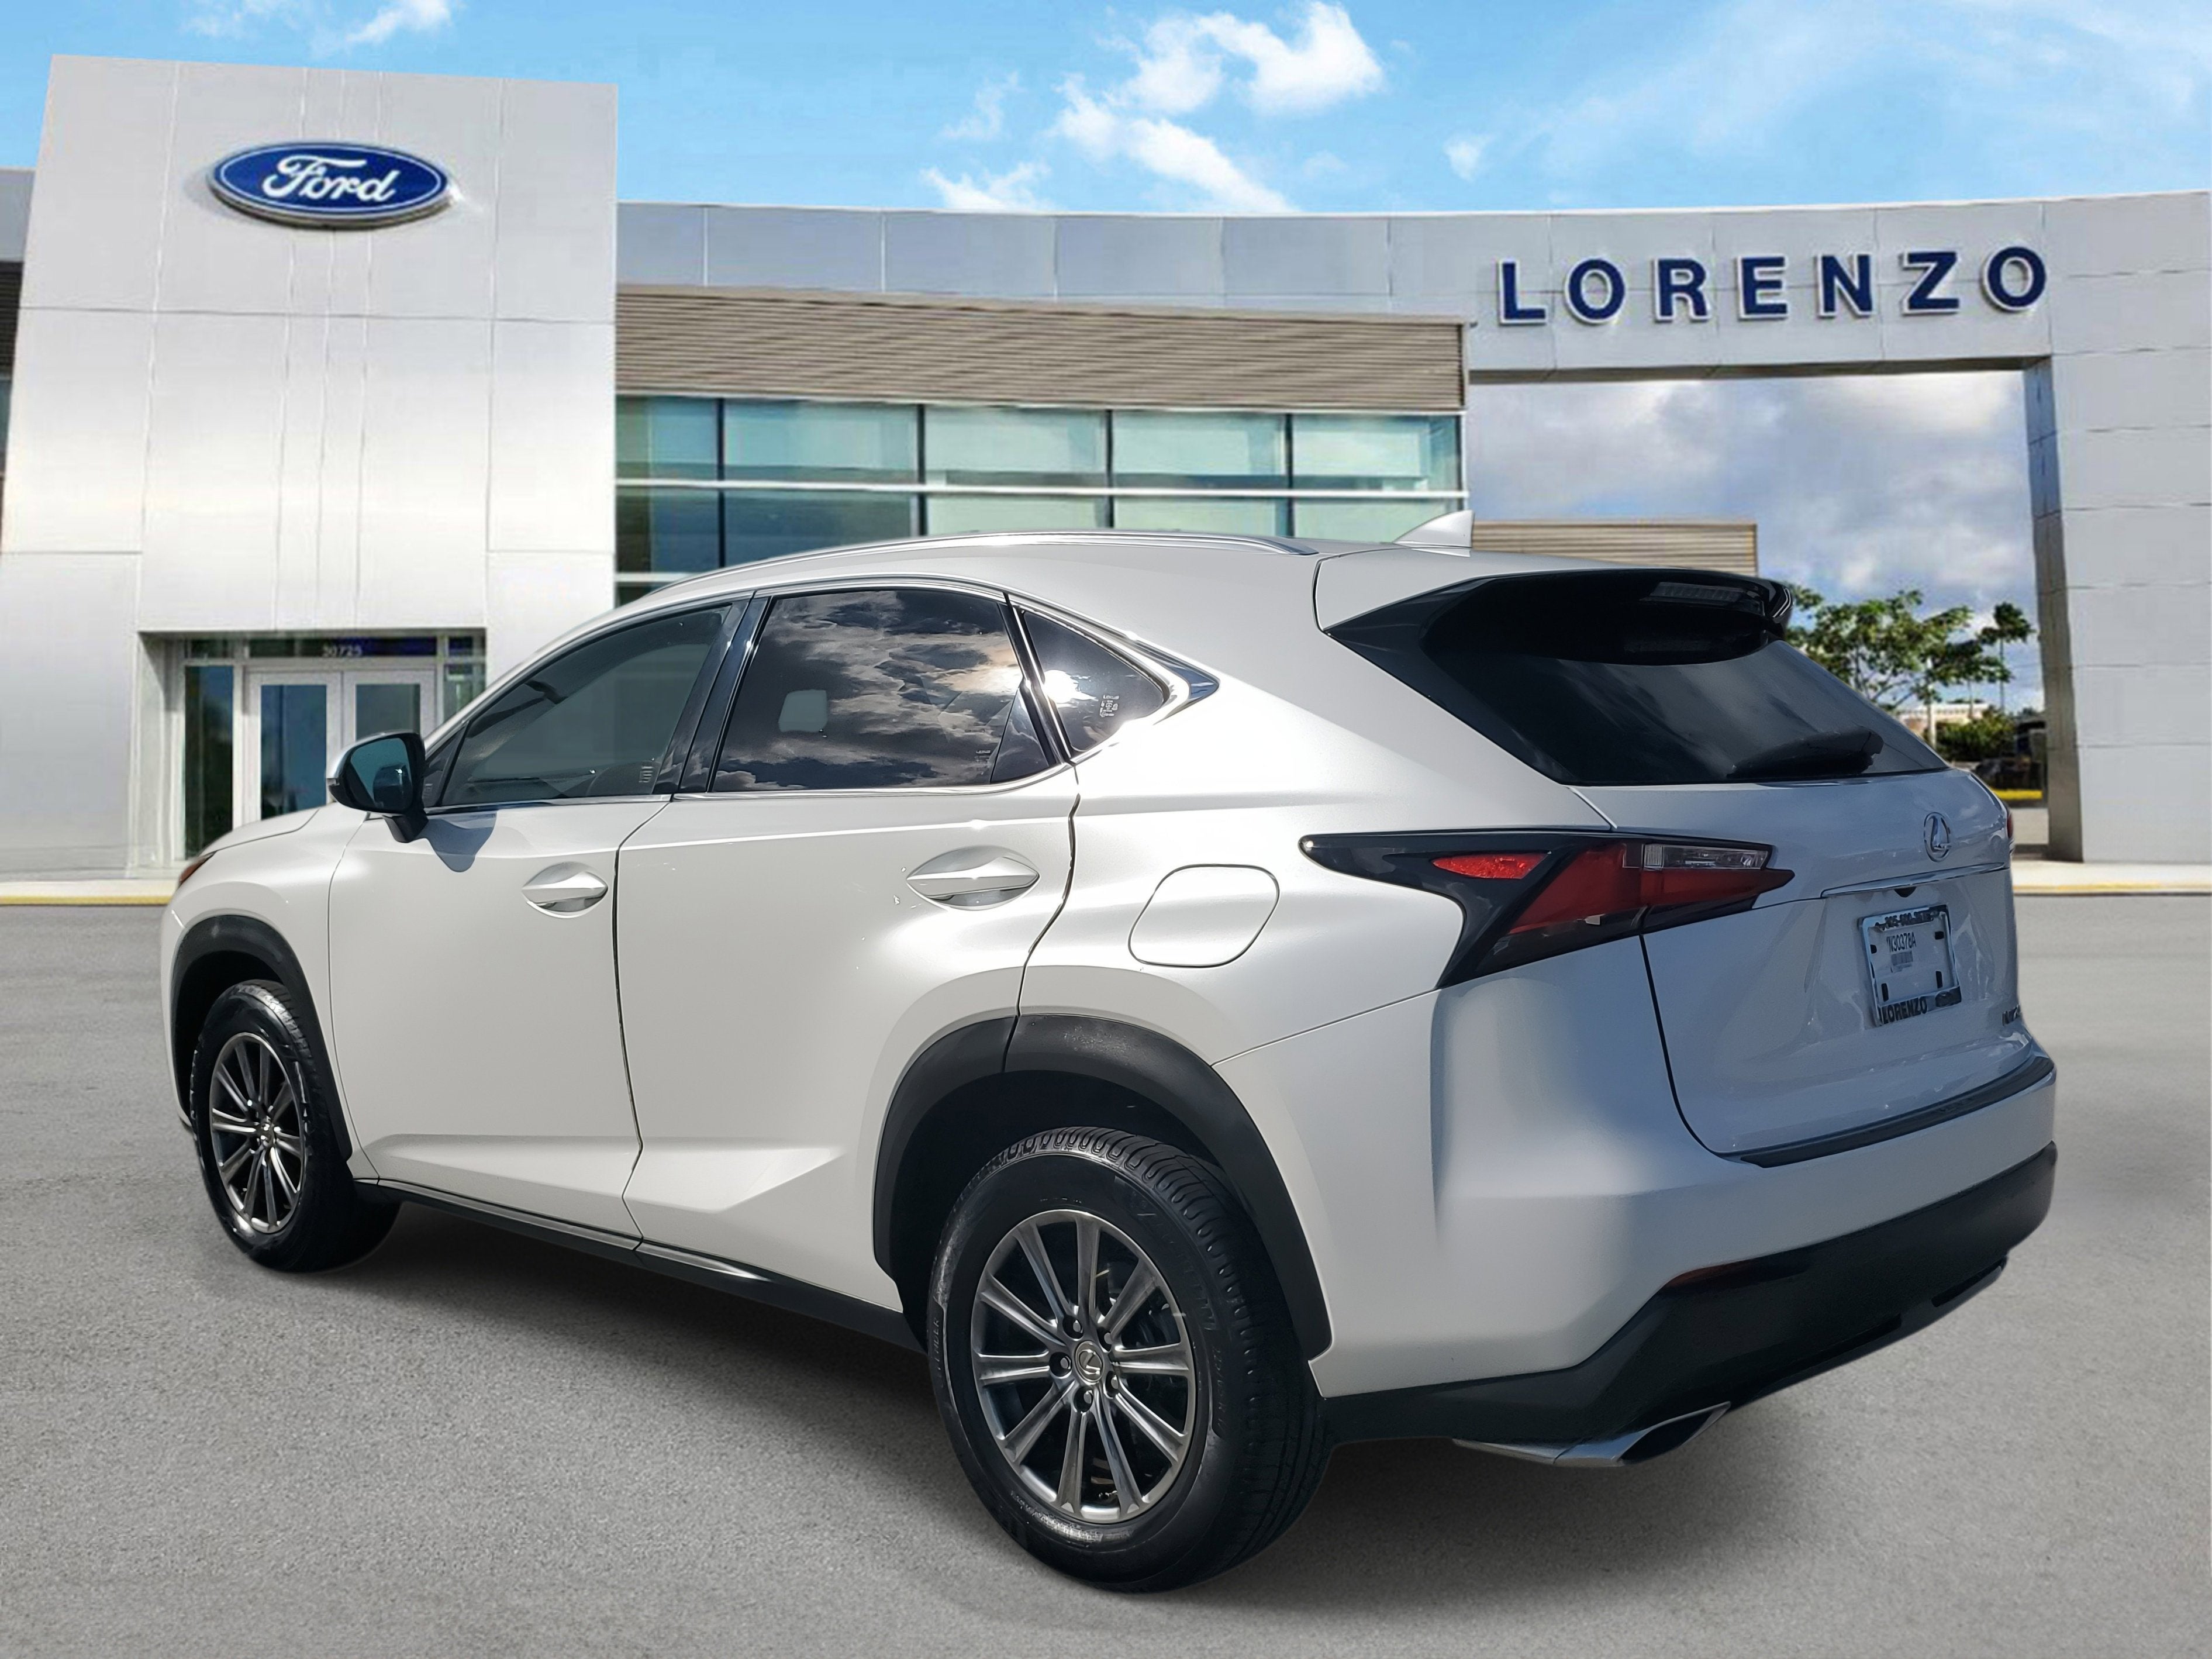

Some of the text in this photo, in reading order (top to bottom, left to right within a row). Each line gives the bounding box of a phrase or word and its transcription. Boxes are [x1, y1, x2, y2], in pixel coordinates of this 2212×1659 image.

[262, 154, 400, 202] Ford
[1498, 246, 2047, 325] LORENZO
[1881, 996, 1928, 1025] LORENZO
